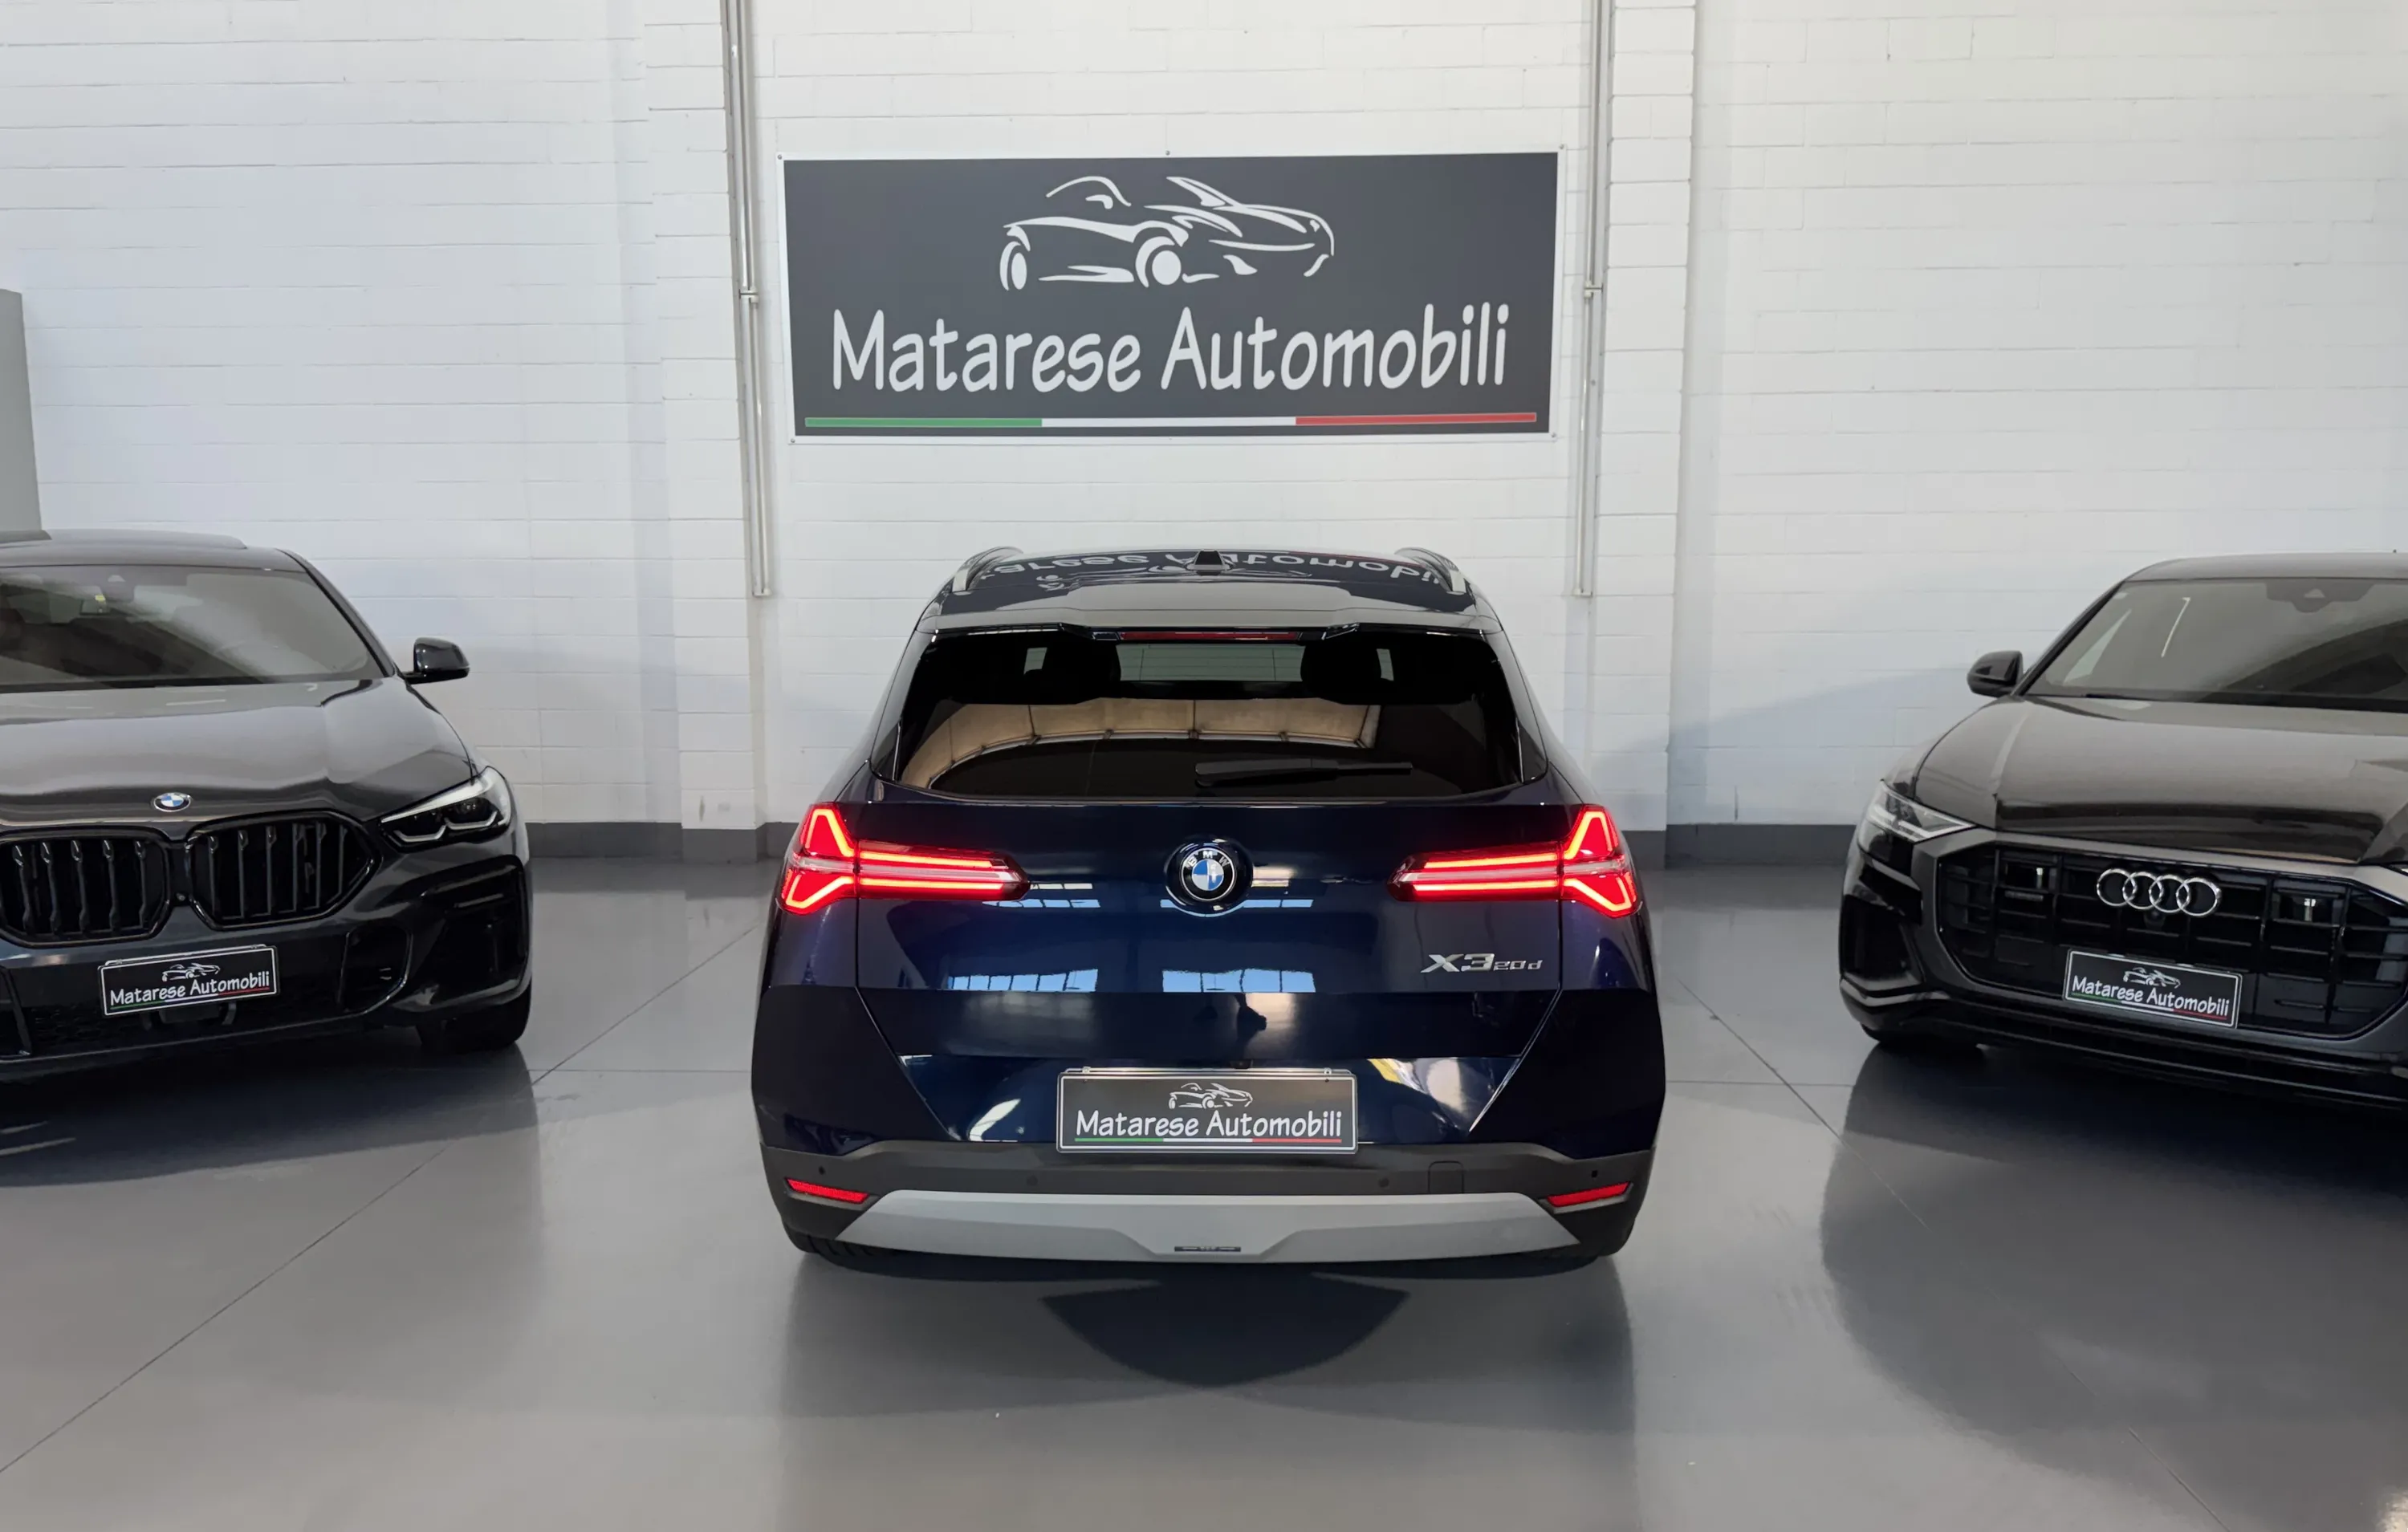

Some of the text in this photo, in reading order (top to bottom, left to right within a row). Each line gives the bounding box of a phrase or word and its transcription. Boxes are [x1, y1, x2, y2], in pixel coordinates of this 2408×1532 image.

[833, 302, 1509, 393] Matarese Automobili
[1186, 851, 1230, 868] BMW
[1420, 953, 1544, 973] X3 20d
[109, 970, 270, 1006] Matarese Automobili
[2072, 974, 2230, 1017] Matarese Automobili
[1076, 1109, 1342, 1137] Matarese Automobili
